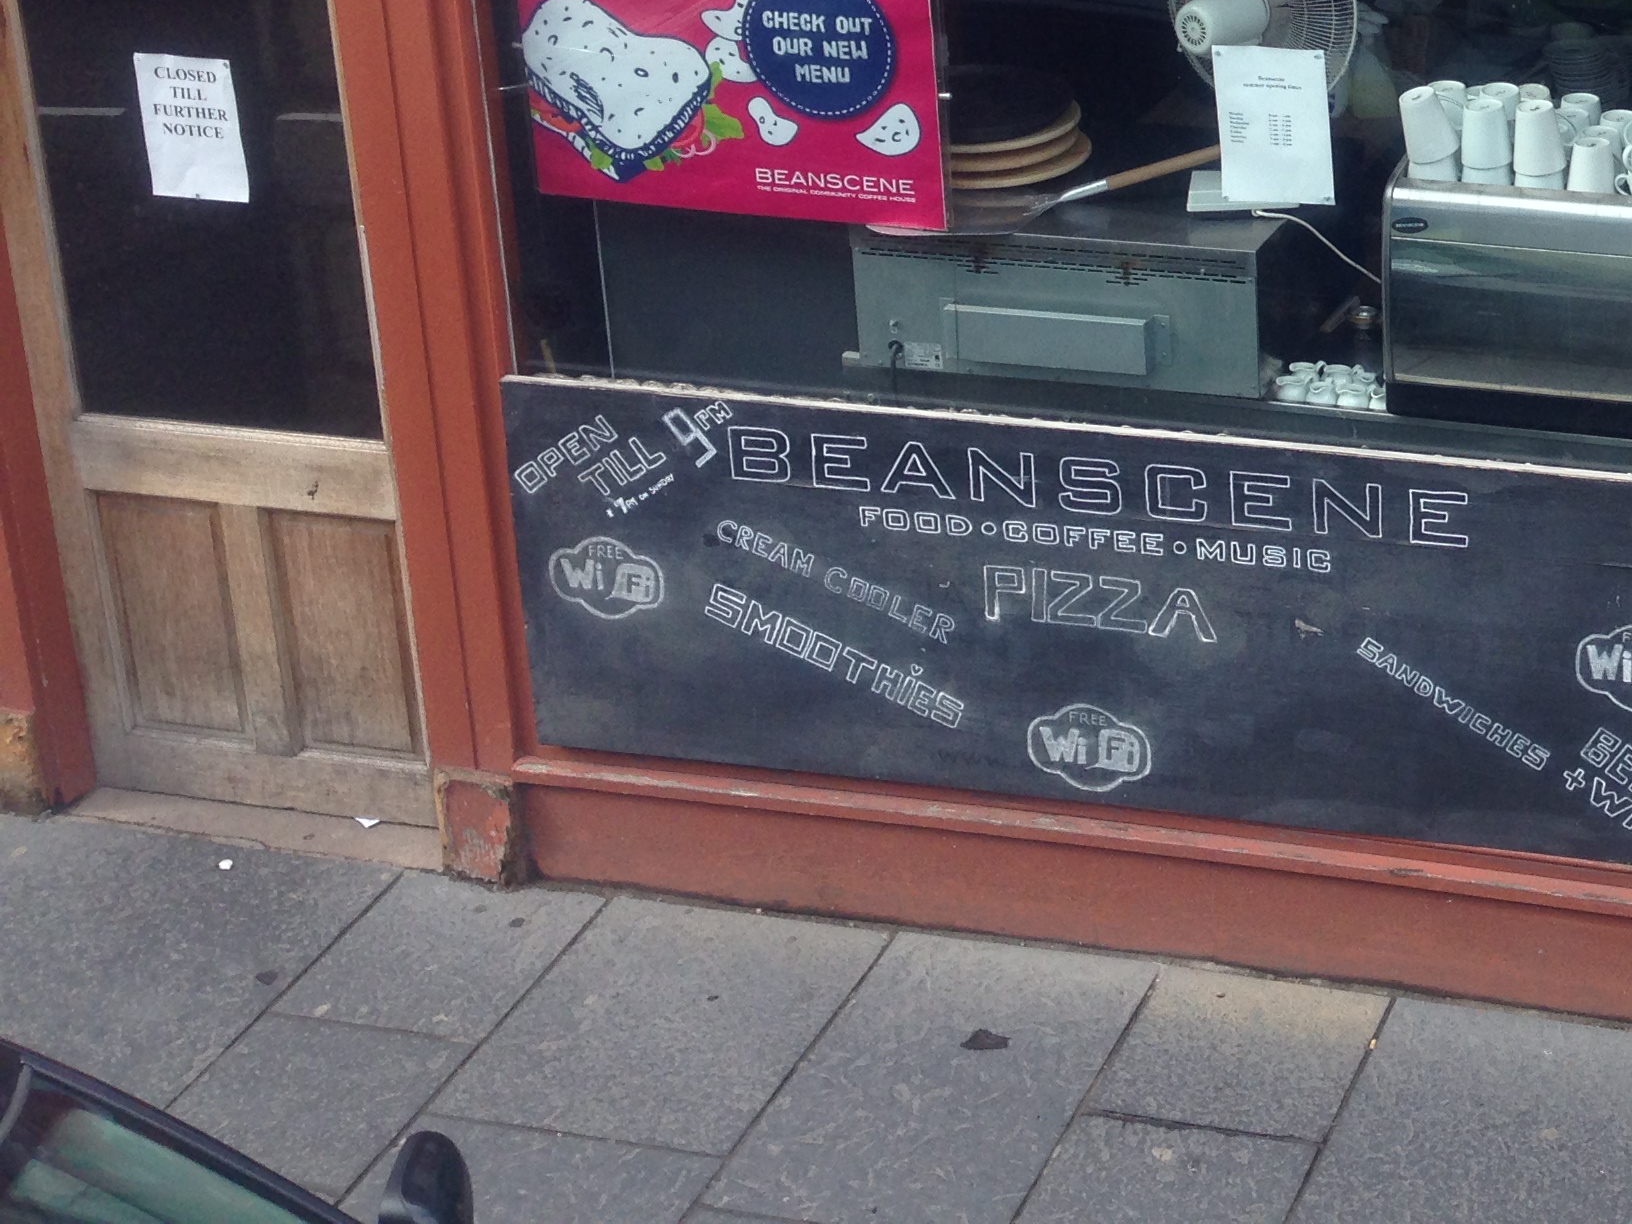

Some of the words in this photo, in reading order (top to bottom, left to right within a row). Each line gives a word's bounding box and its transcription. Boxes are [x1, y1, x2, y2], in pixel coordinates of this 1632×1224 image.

[761, 10, 826, 34] CHECK
[834, 15, 873, 36] OUT
[772, 35, 814, 57] OUR
[822, 40, 869, 60] NEW
[153, 65, 218, 85] CLOSED
[794, 62, 851, 84] MENU
[169, 85, 208, 102] TILL
[153, 103, 229, 122] FURTHER
[162, 121, 225, 140] NOTICE
[755, 167, 916, 195] BEANSCENE
[756, 184, 772, 193] THE
[858, 193, 888, 202] COFFEE
[889, 196, 917, 204] HOUSE
[513, 414, 619, 494] OPEN
[577, 436, 667, 497] TILL
[727, 424, 1469, 548] BEANSCENE
[858, 505, 973, 537] FOOD
[1002, 520, 1165, 556] COFFEE
[1195, 538, 1333, 573] MUSIC
[587, 544, 625, 560] FREE
[715, 519, 816, 579] CREAM
[822, 566, 956, 645] COOLER
[983, 563, 1219, 644] PIZZA
[1356, 636, 1551, 772] SANDWICHES
[1069, 710, 1108, 727] FREE
